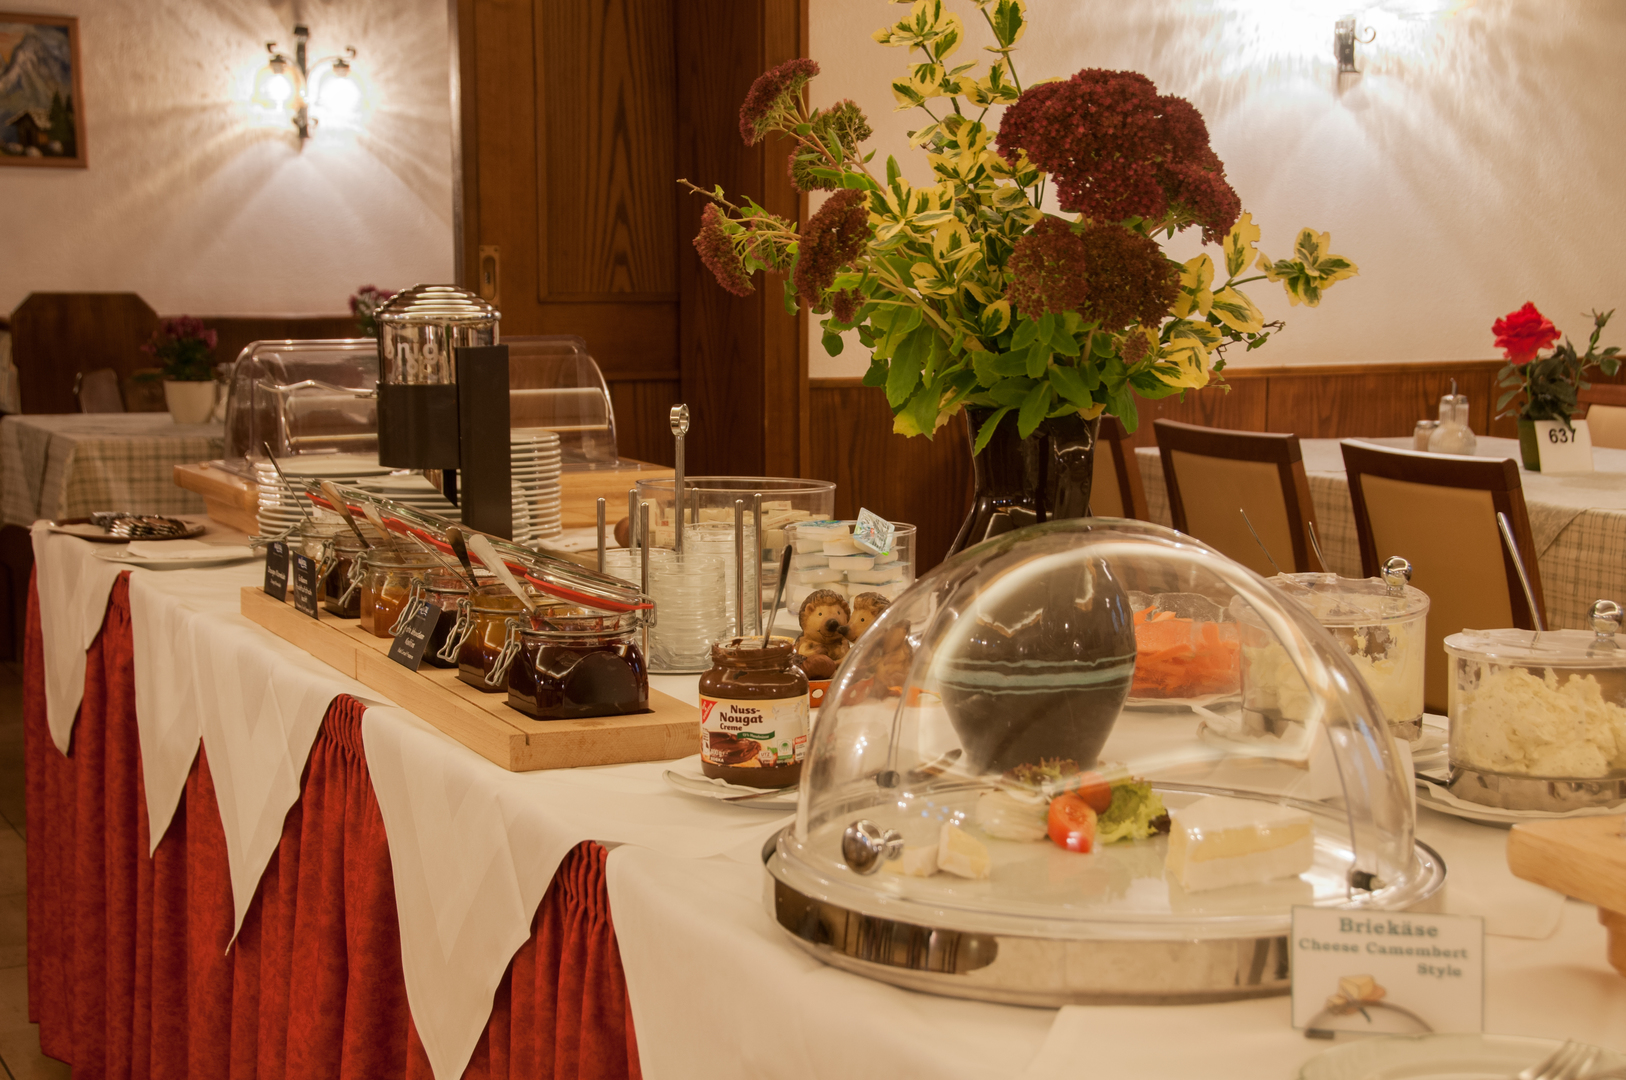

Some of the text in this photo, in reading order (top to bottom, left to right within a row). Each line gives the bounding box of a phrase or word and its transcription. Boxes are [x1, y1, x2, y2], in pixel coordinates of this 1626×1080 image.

[730, 705, 760, 714] Nuss-
[720, 712, 763, 726] Nougat
[720, 723, 742, 731] Creme
[1339, 918, 1438, 937] Briekäse
[1299, 938, 1468, 959] Cheese Camembert
[1417, 963, 1462, 978] Style
